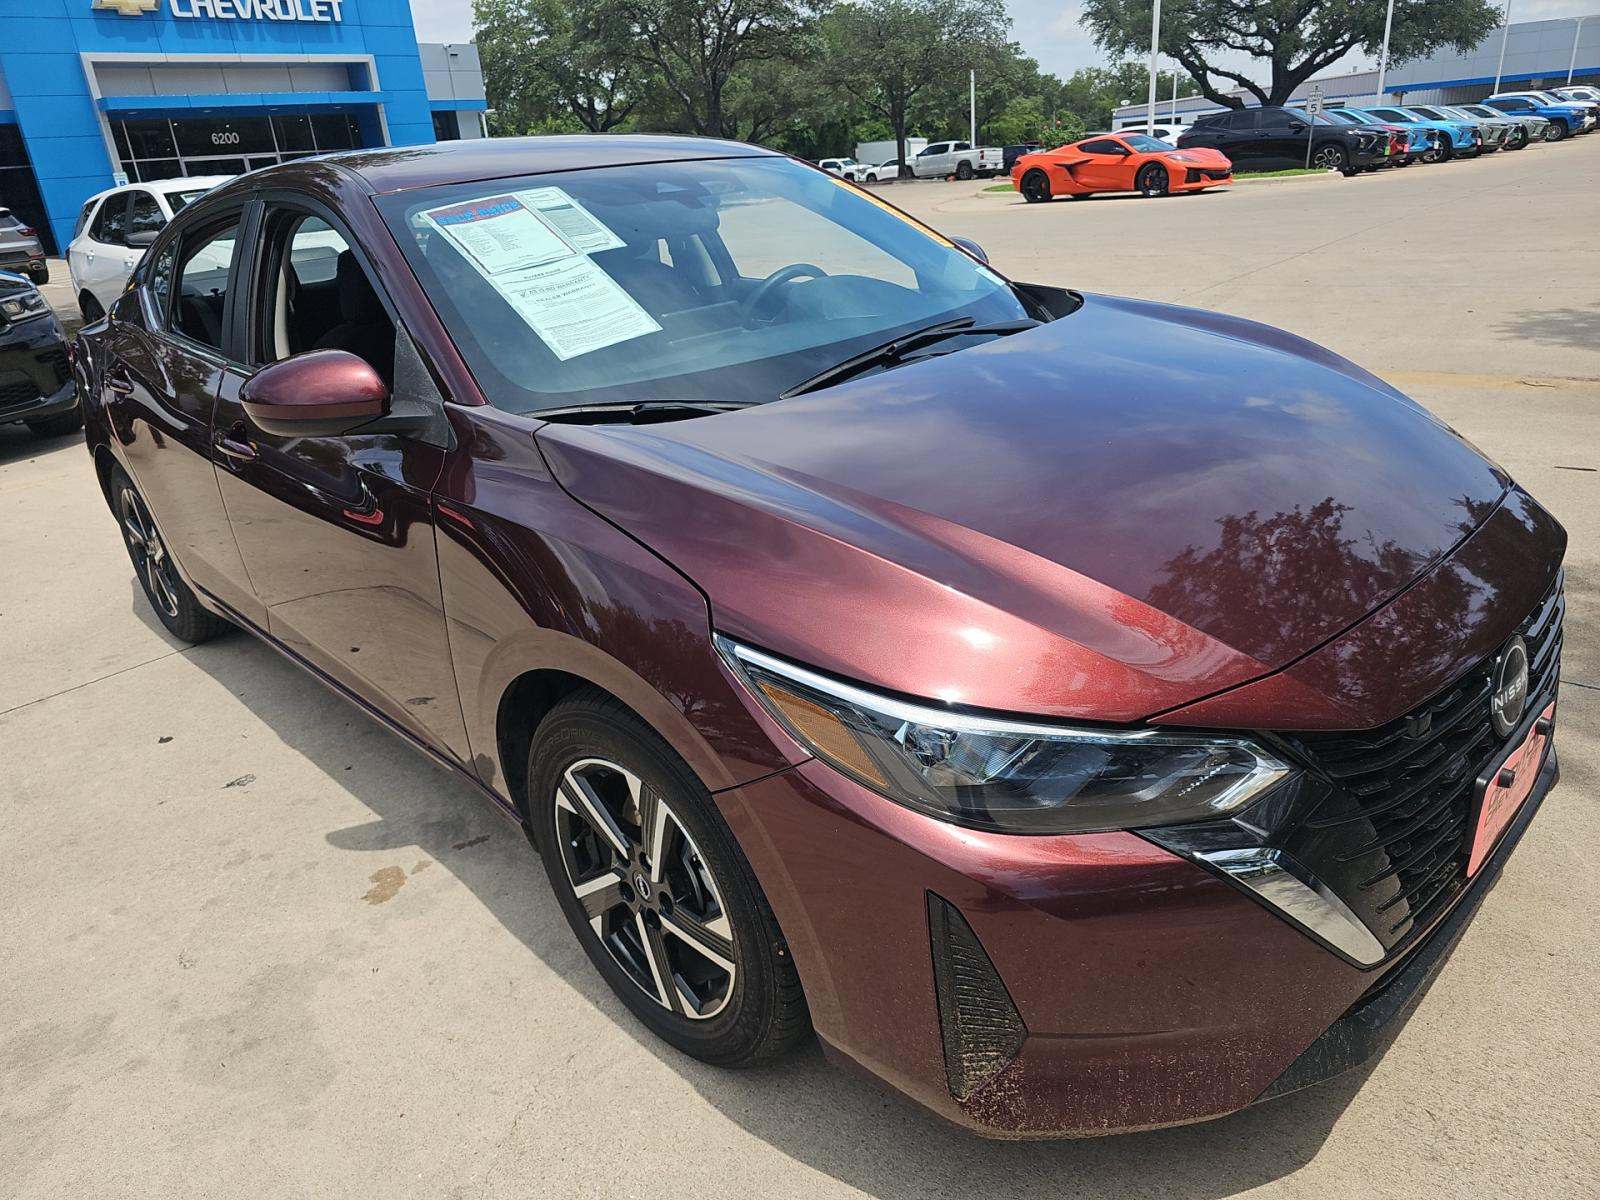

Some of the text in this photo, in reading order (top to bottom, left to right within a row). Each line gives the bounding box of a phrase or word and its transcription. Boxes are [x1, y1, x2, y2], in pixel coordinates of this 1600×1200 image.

[170, 0, 343, 22] CHEVROLET
[1310, 103, 1318, 113] 5
[211, 132, 240, 145] 6200
[1494, 671, 1527, 711] NISSA
